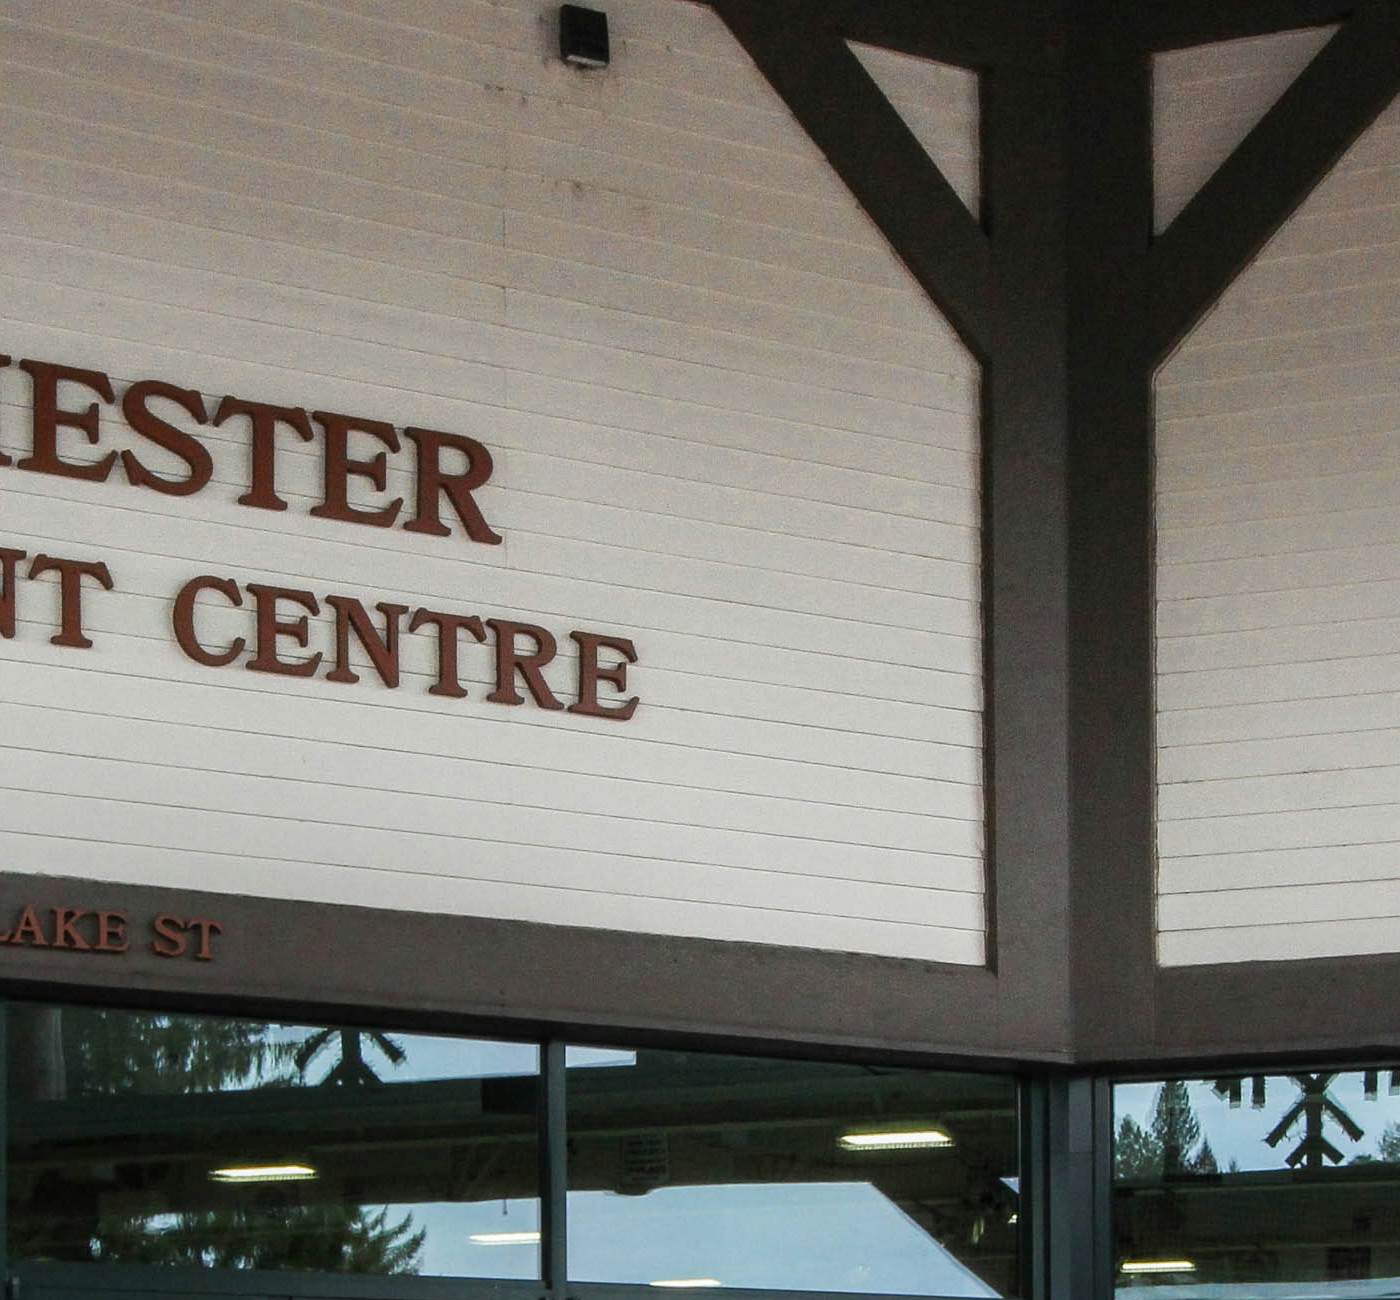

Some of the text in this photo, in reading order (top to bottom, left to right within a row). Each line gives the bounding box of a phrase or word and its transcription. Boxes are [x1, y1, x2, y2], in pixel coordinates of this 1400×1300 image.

[0, 353, 502, 545] ESTER
[172, 574, 640, 721] CENTRE
[0, 902, 224, 960] AKE ST
